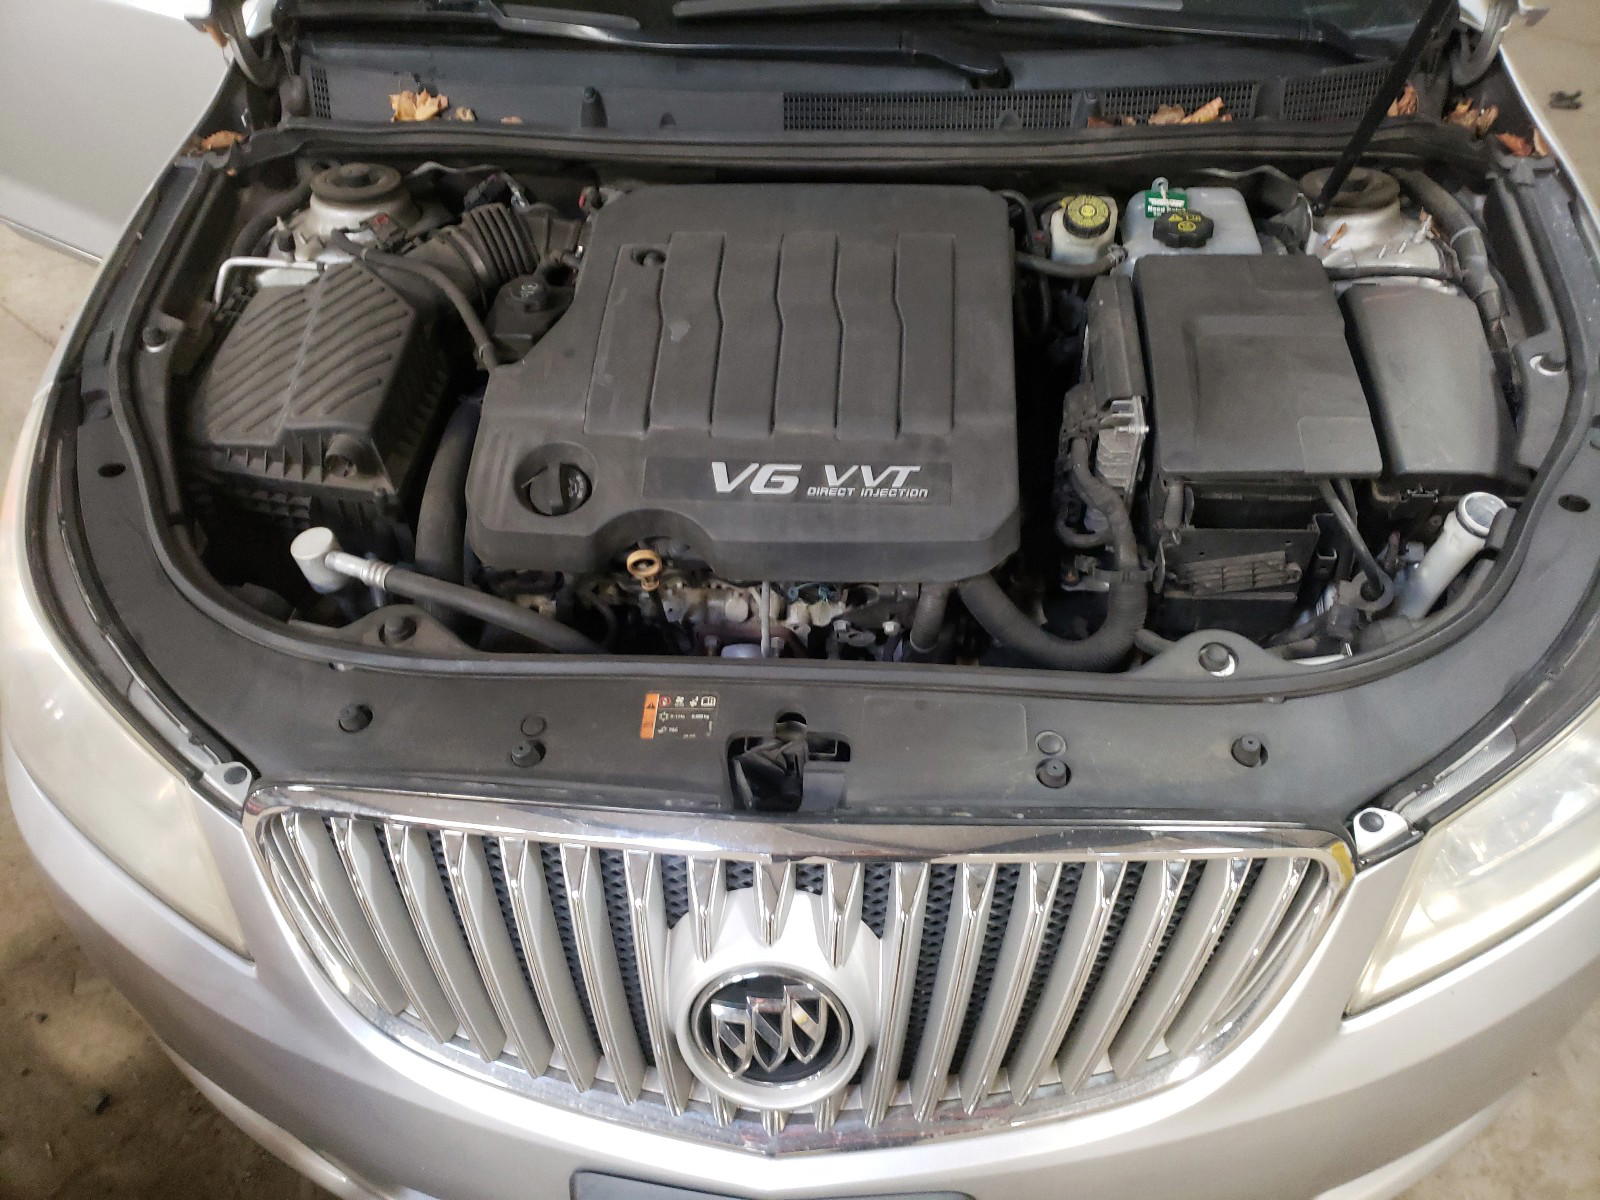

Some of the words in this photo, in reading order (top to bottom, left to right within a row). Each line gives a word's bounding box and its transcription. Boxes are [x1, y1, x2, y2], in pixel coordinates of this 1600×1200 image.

[711, 461, 803, 495] V6
[824, 464, 922, 488] VVT
[807, 486, 855, 497] DIRECT
[860, 487, 929, 498] INJECTION
